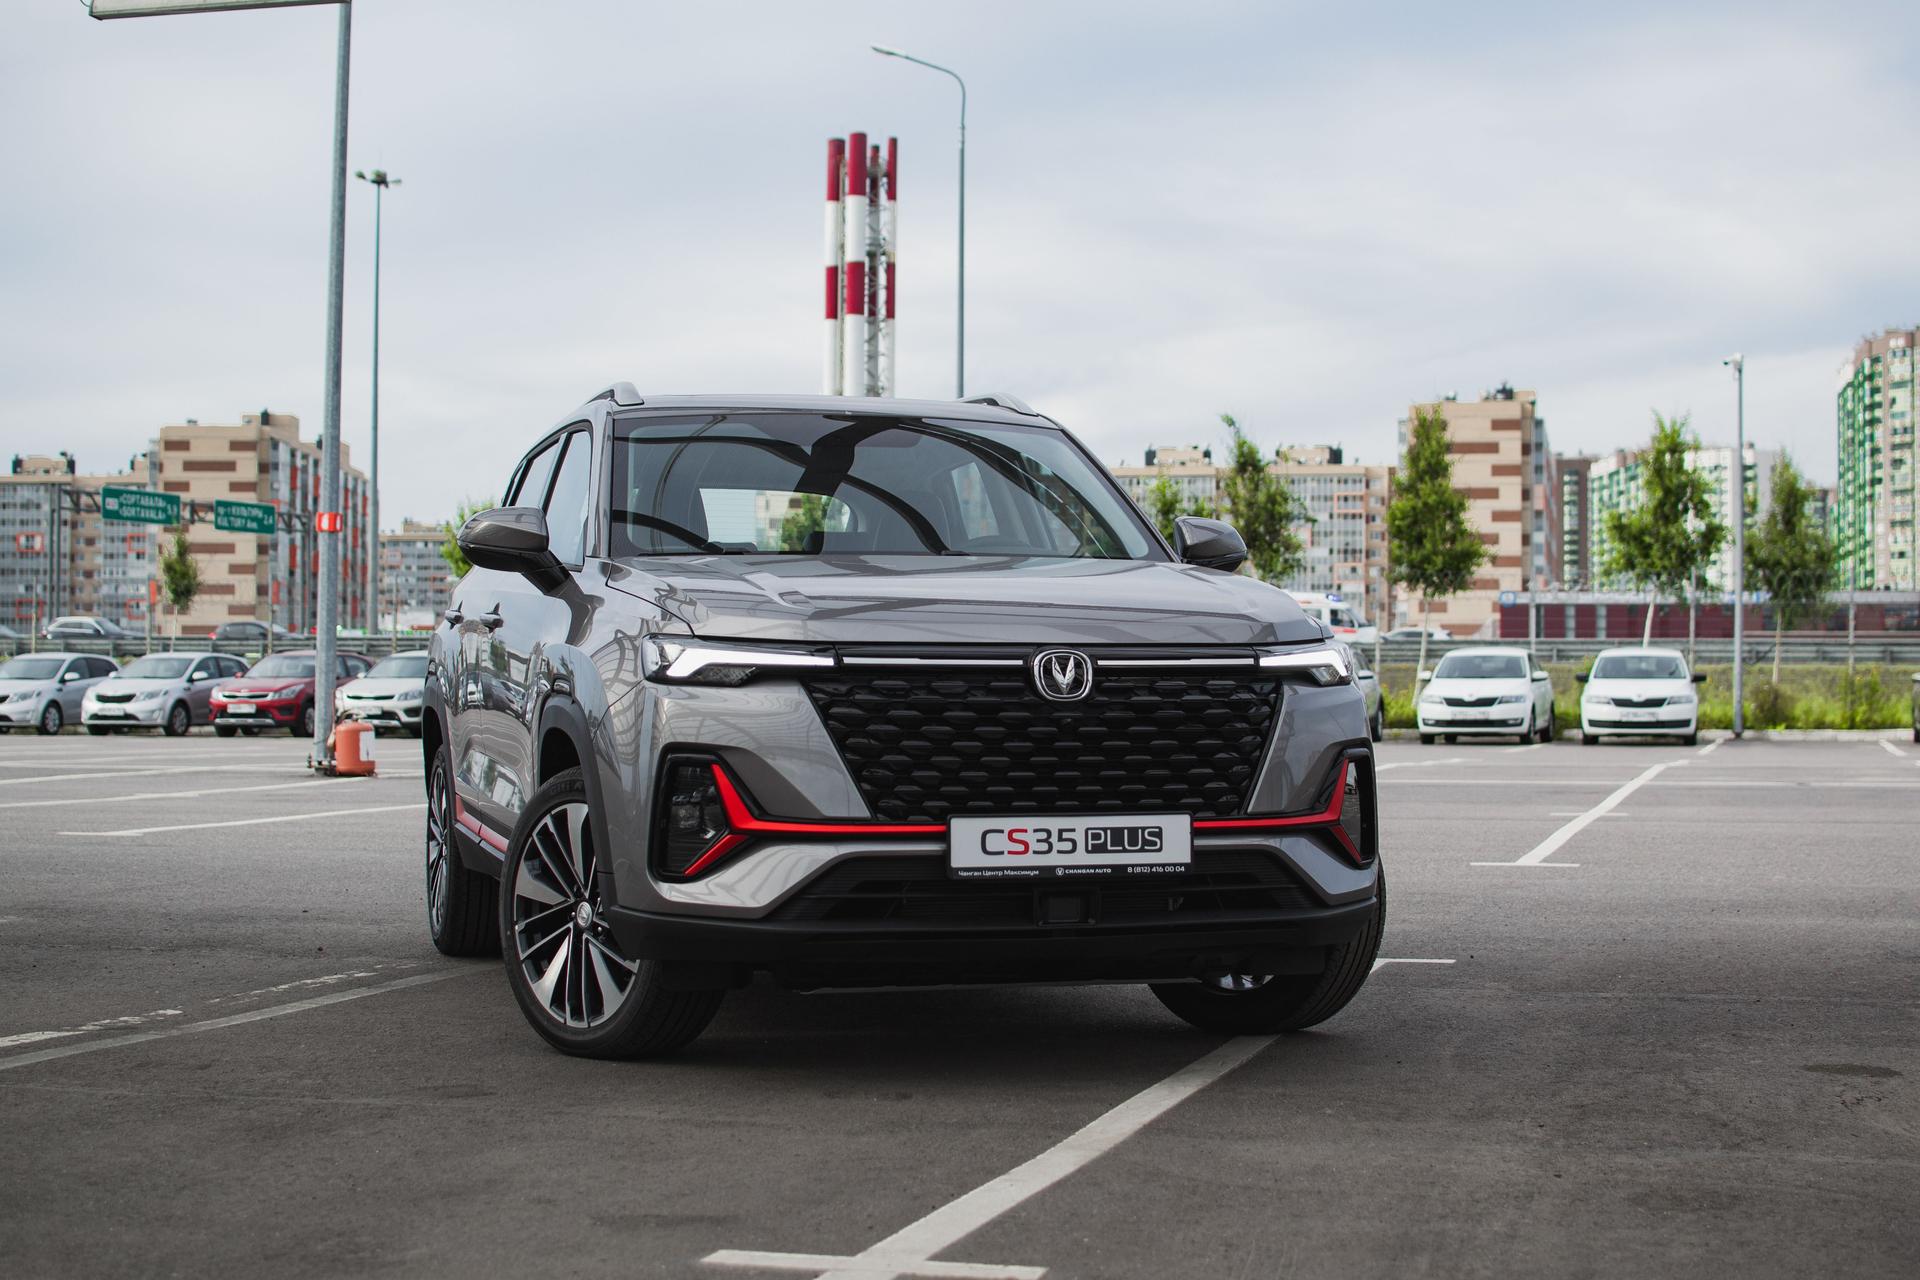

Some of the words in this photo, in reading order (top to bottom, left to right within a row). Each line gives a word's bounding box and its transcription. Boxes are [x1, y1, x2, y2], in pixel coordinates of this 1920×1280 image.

[980, 827, 1078, 856] CS35
[1088, 828, 1161, 851] PLUS
[1003, 869, 1040, 877] Максимум
[1133, 866, 1151, 874] (812)
